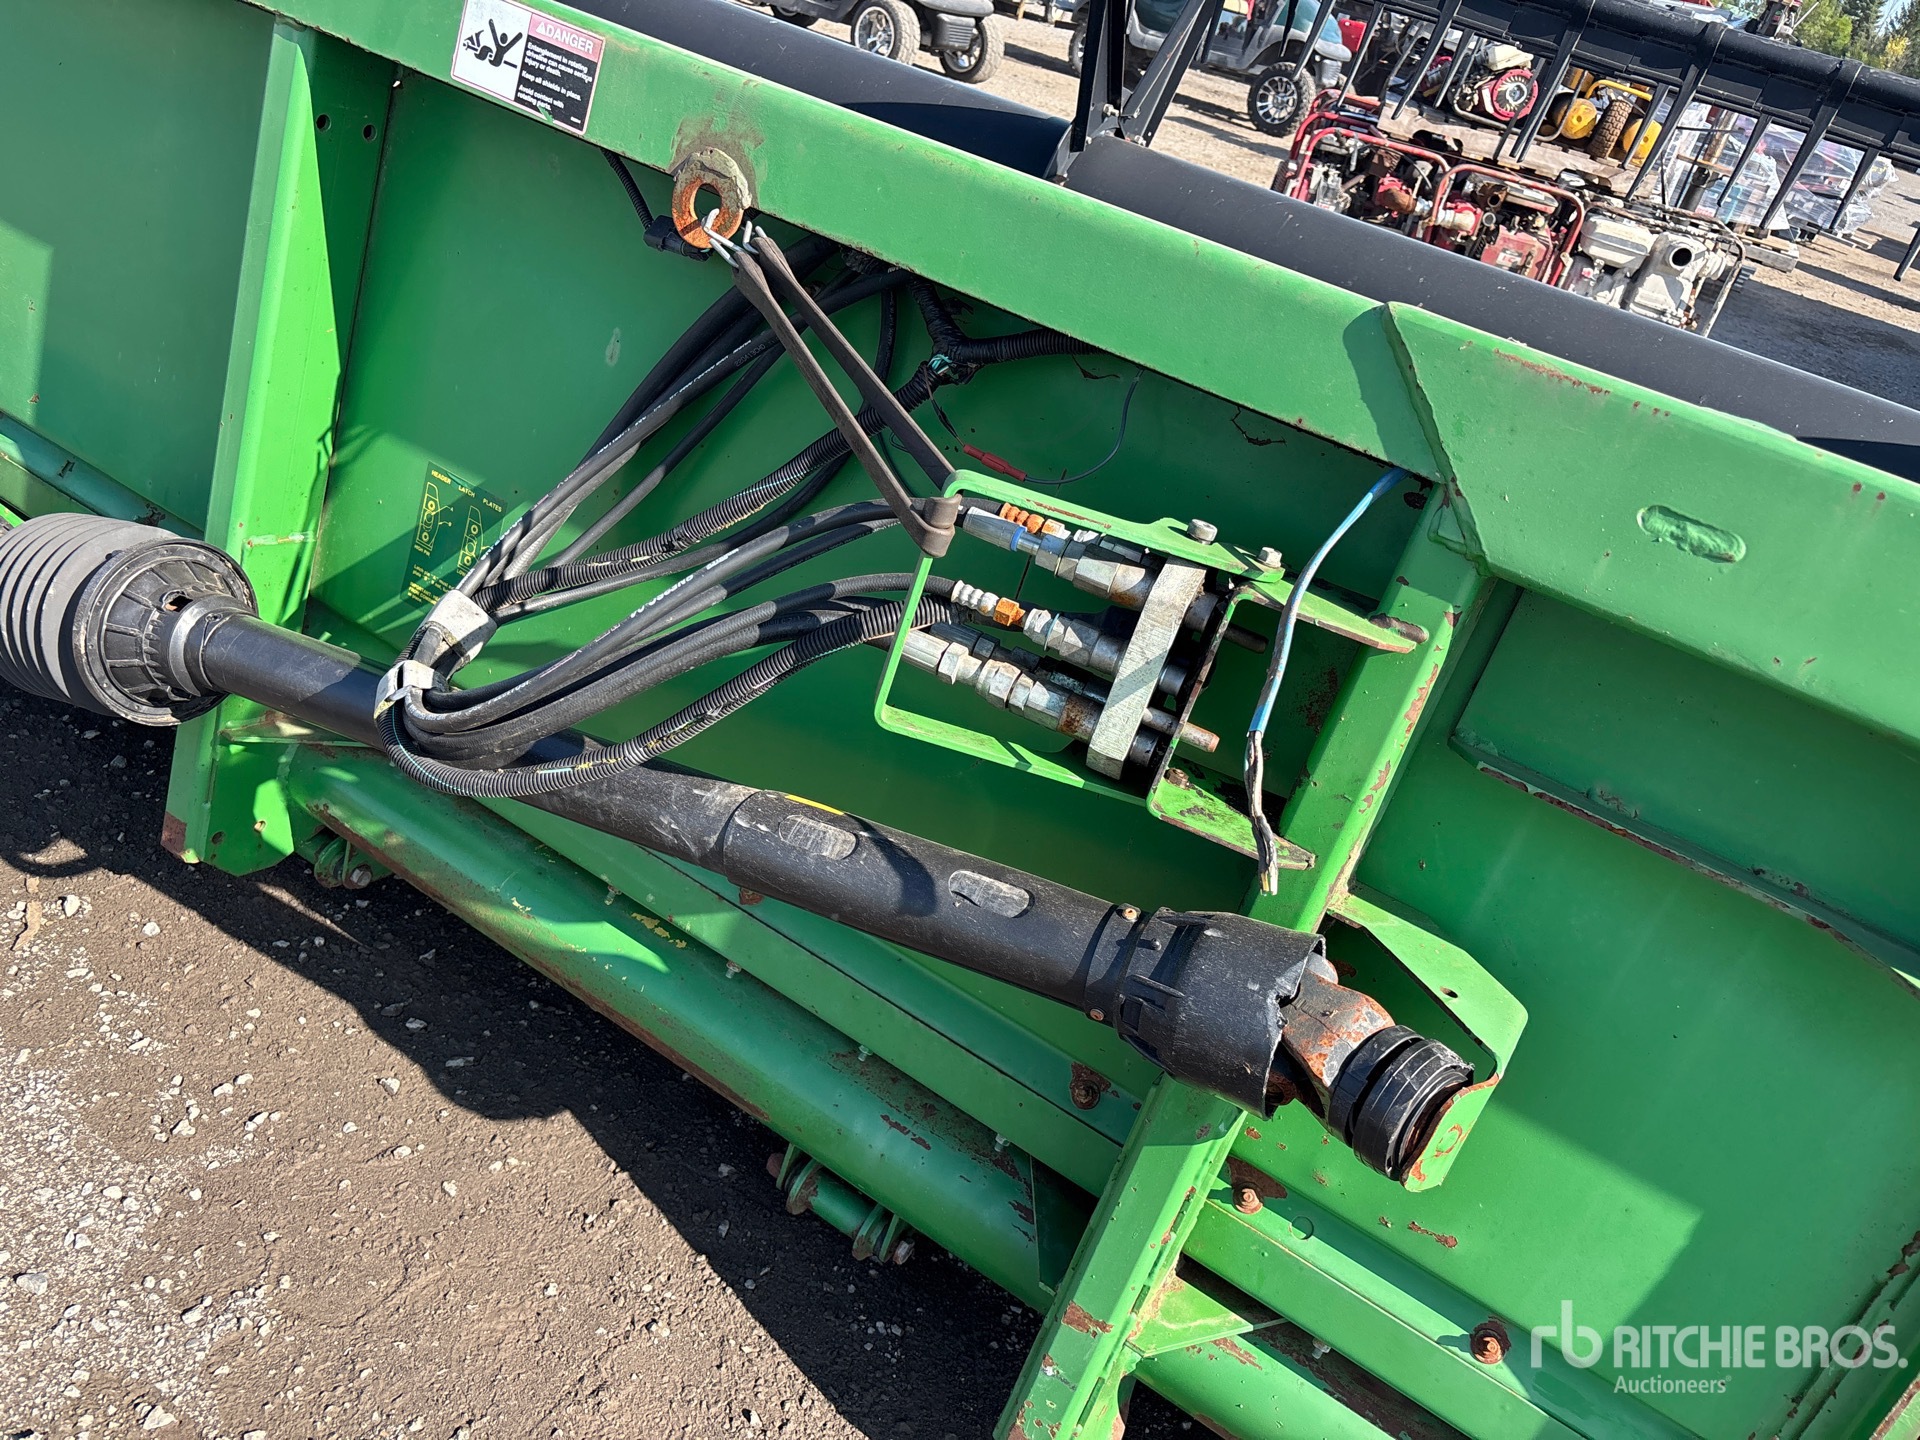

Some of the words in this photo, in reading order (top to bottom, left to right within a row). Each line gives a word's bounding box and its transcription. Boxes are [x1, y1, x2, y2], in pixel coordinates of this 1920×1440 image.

[546, 25, 593, 54] DANGER
[526, 50, 547, 63] driveline
[528, 42, 561, 62] Entanglement
[569, 60, 587, 73] rotating
[517, 92, 536, 105] rotating
[519, 84, 533, 95] Avoid
[534, 91, 552, 104] contact
[554, 99, 564, 108] with
[522, 70, 534, 82] Keep
[543, 79, 560, 92] shields
[567, 90, 581, 101] place.
[432, 470, 451, 485] HEADER
[459, 485, 475, 498] LATCH
[483, 498, 501, 513] PLATES
